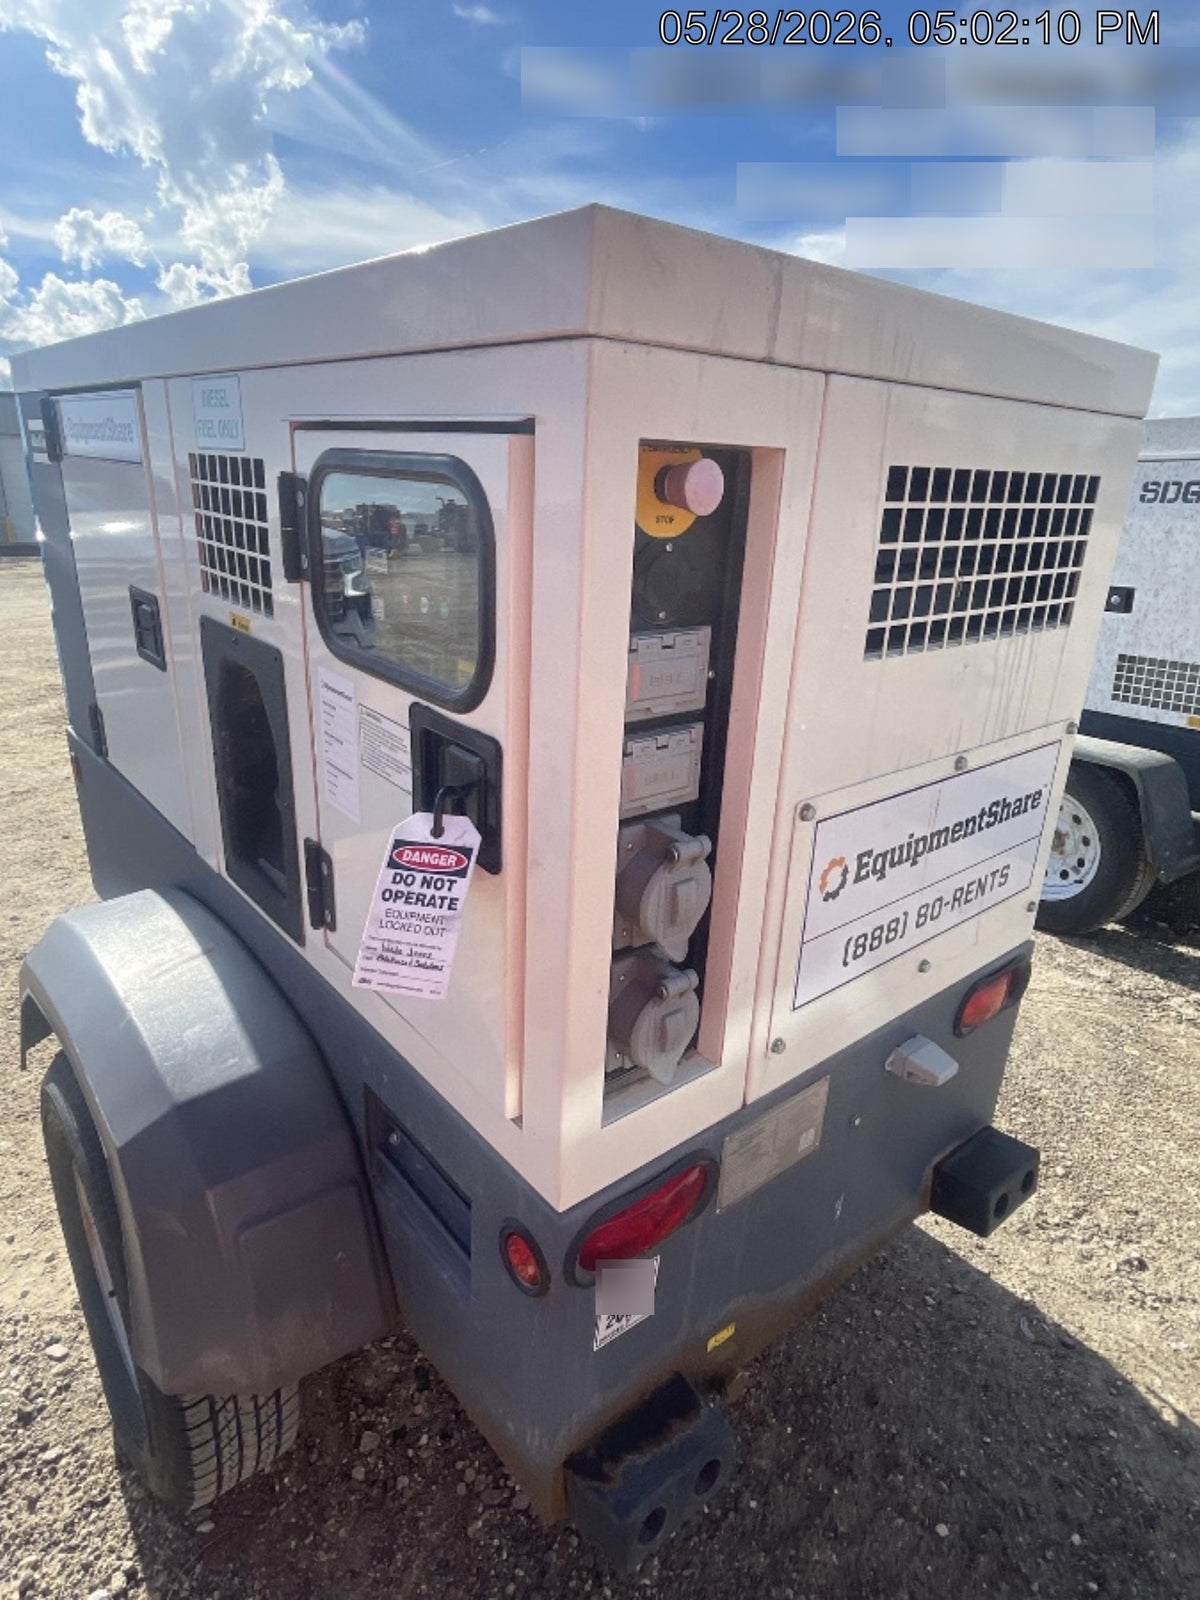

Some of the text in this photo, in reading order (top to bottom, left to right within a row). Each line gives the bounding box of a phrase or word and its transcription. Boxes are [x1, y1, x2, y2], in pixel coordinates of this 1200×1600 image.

[200, 389, 230, 407] DIESEL
[197, 419, 239, 439] FUEL ONLY
[655, 514, 674, 525] STOP
[853, 789, 1042, 884] EquipmentShare
[402, 849, 458, 868] DANGER
[391, 872, 458, 892] DO NOT
[381, 888, 459, 911] OPERATE
[385, 908, 445, 925] EQUIPMENT
[842, 864, 1011, 968] (888) 80-RENTS
[379, 920, 447, 937] LOCKED OUT
